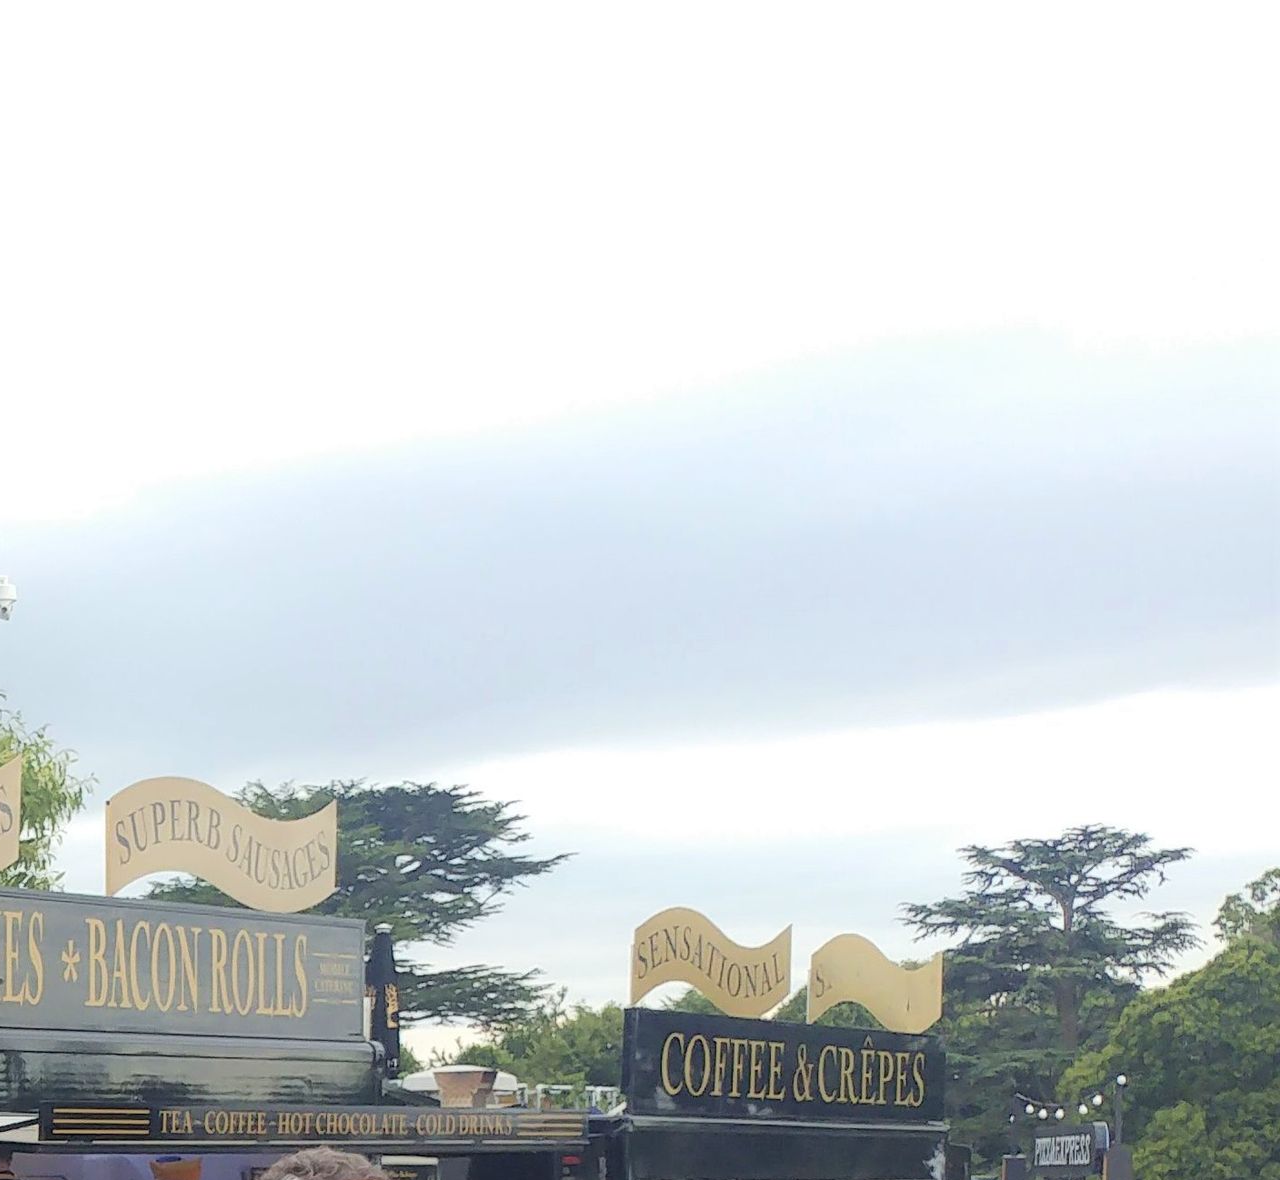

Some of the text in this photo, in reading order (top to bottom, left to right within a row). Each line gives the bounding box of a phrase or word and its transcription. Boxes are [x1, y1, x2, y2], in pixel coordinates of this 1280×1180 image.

[115, 799, 331, 893] SUPERB SAUSAGES
[85, 918, 202, 1013] BACON
[209, 928, 309, 1019] ROLLS
[637, 926, 784, 998] SENSATIONAL
[662, 1032, 786, 1100] COFFEE
[159, 1110, 513, 1136] TEA COFFEE HOT CHOCOLATE COLD DRINKS
